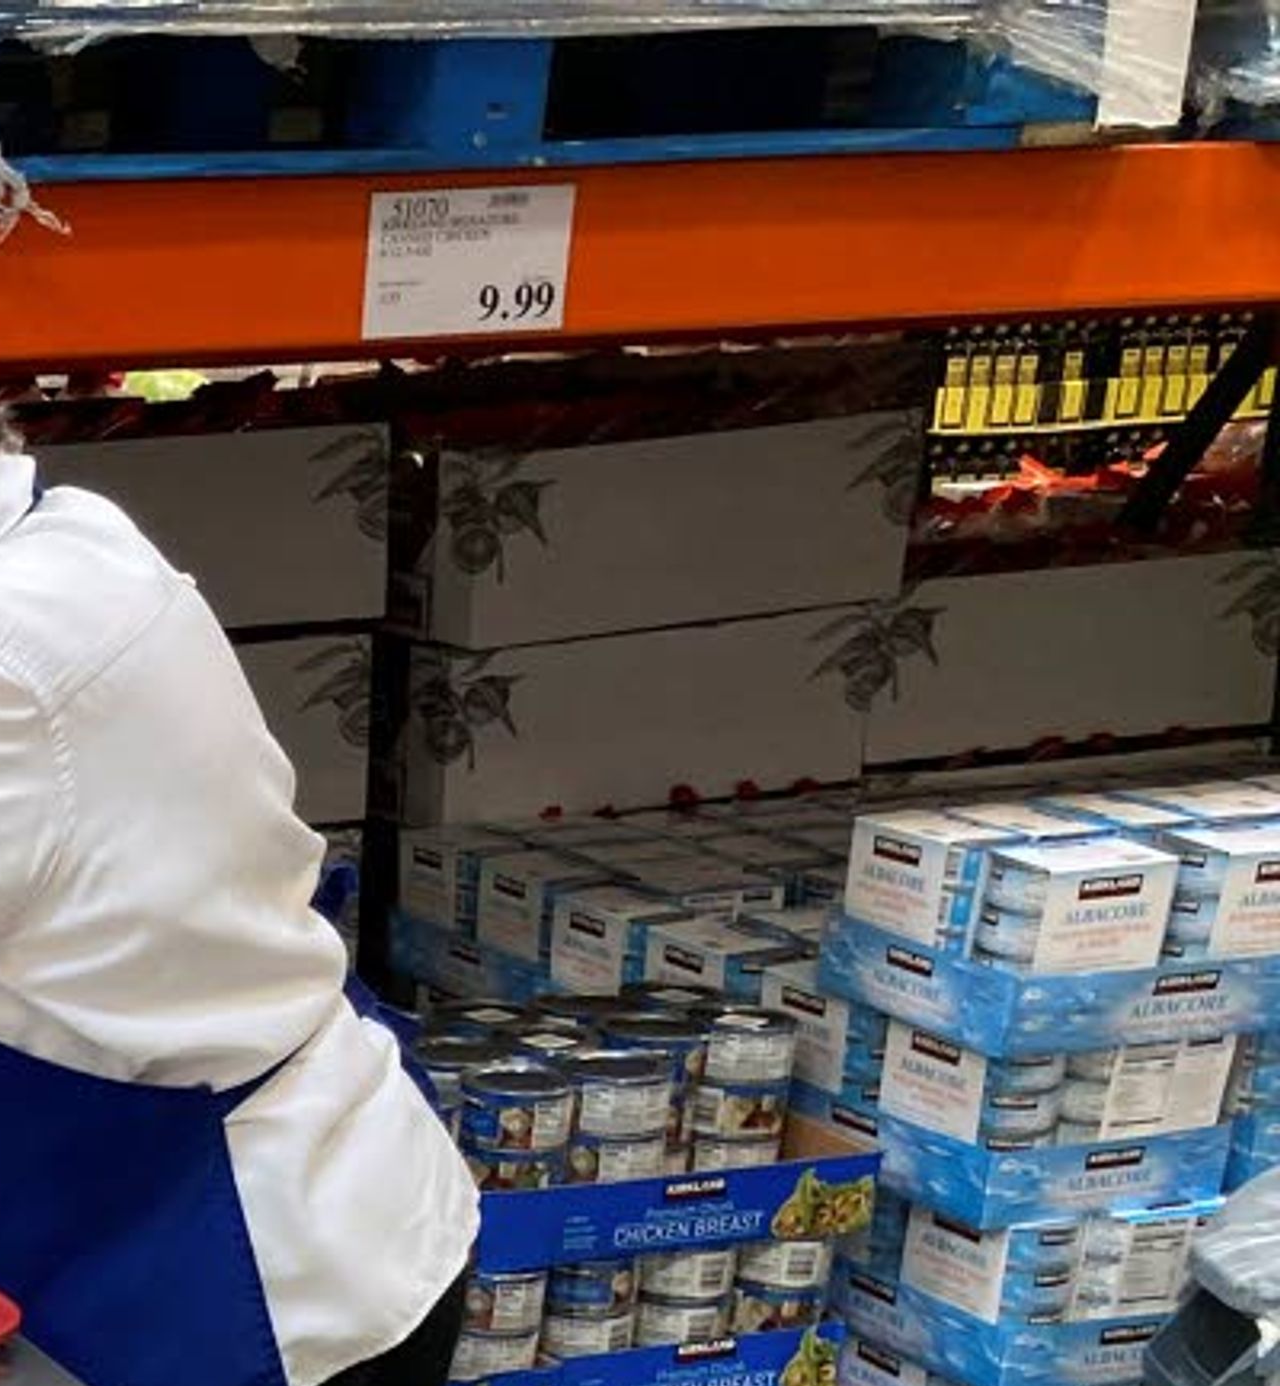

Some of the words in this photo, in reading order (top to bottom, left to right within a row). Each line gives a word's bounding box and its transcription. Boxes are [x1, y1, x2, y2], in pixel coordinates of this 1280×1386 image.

[478, 281, 555, 322] 9.99
[614, 1217, 691, 1247] CHICKEN
[694, 1211, 766, 1237] BREAST
